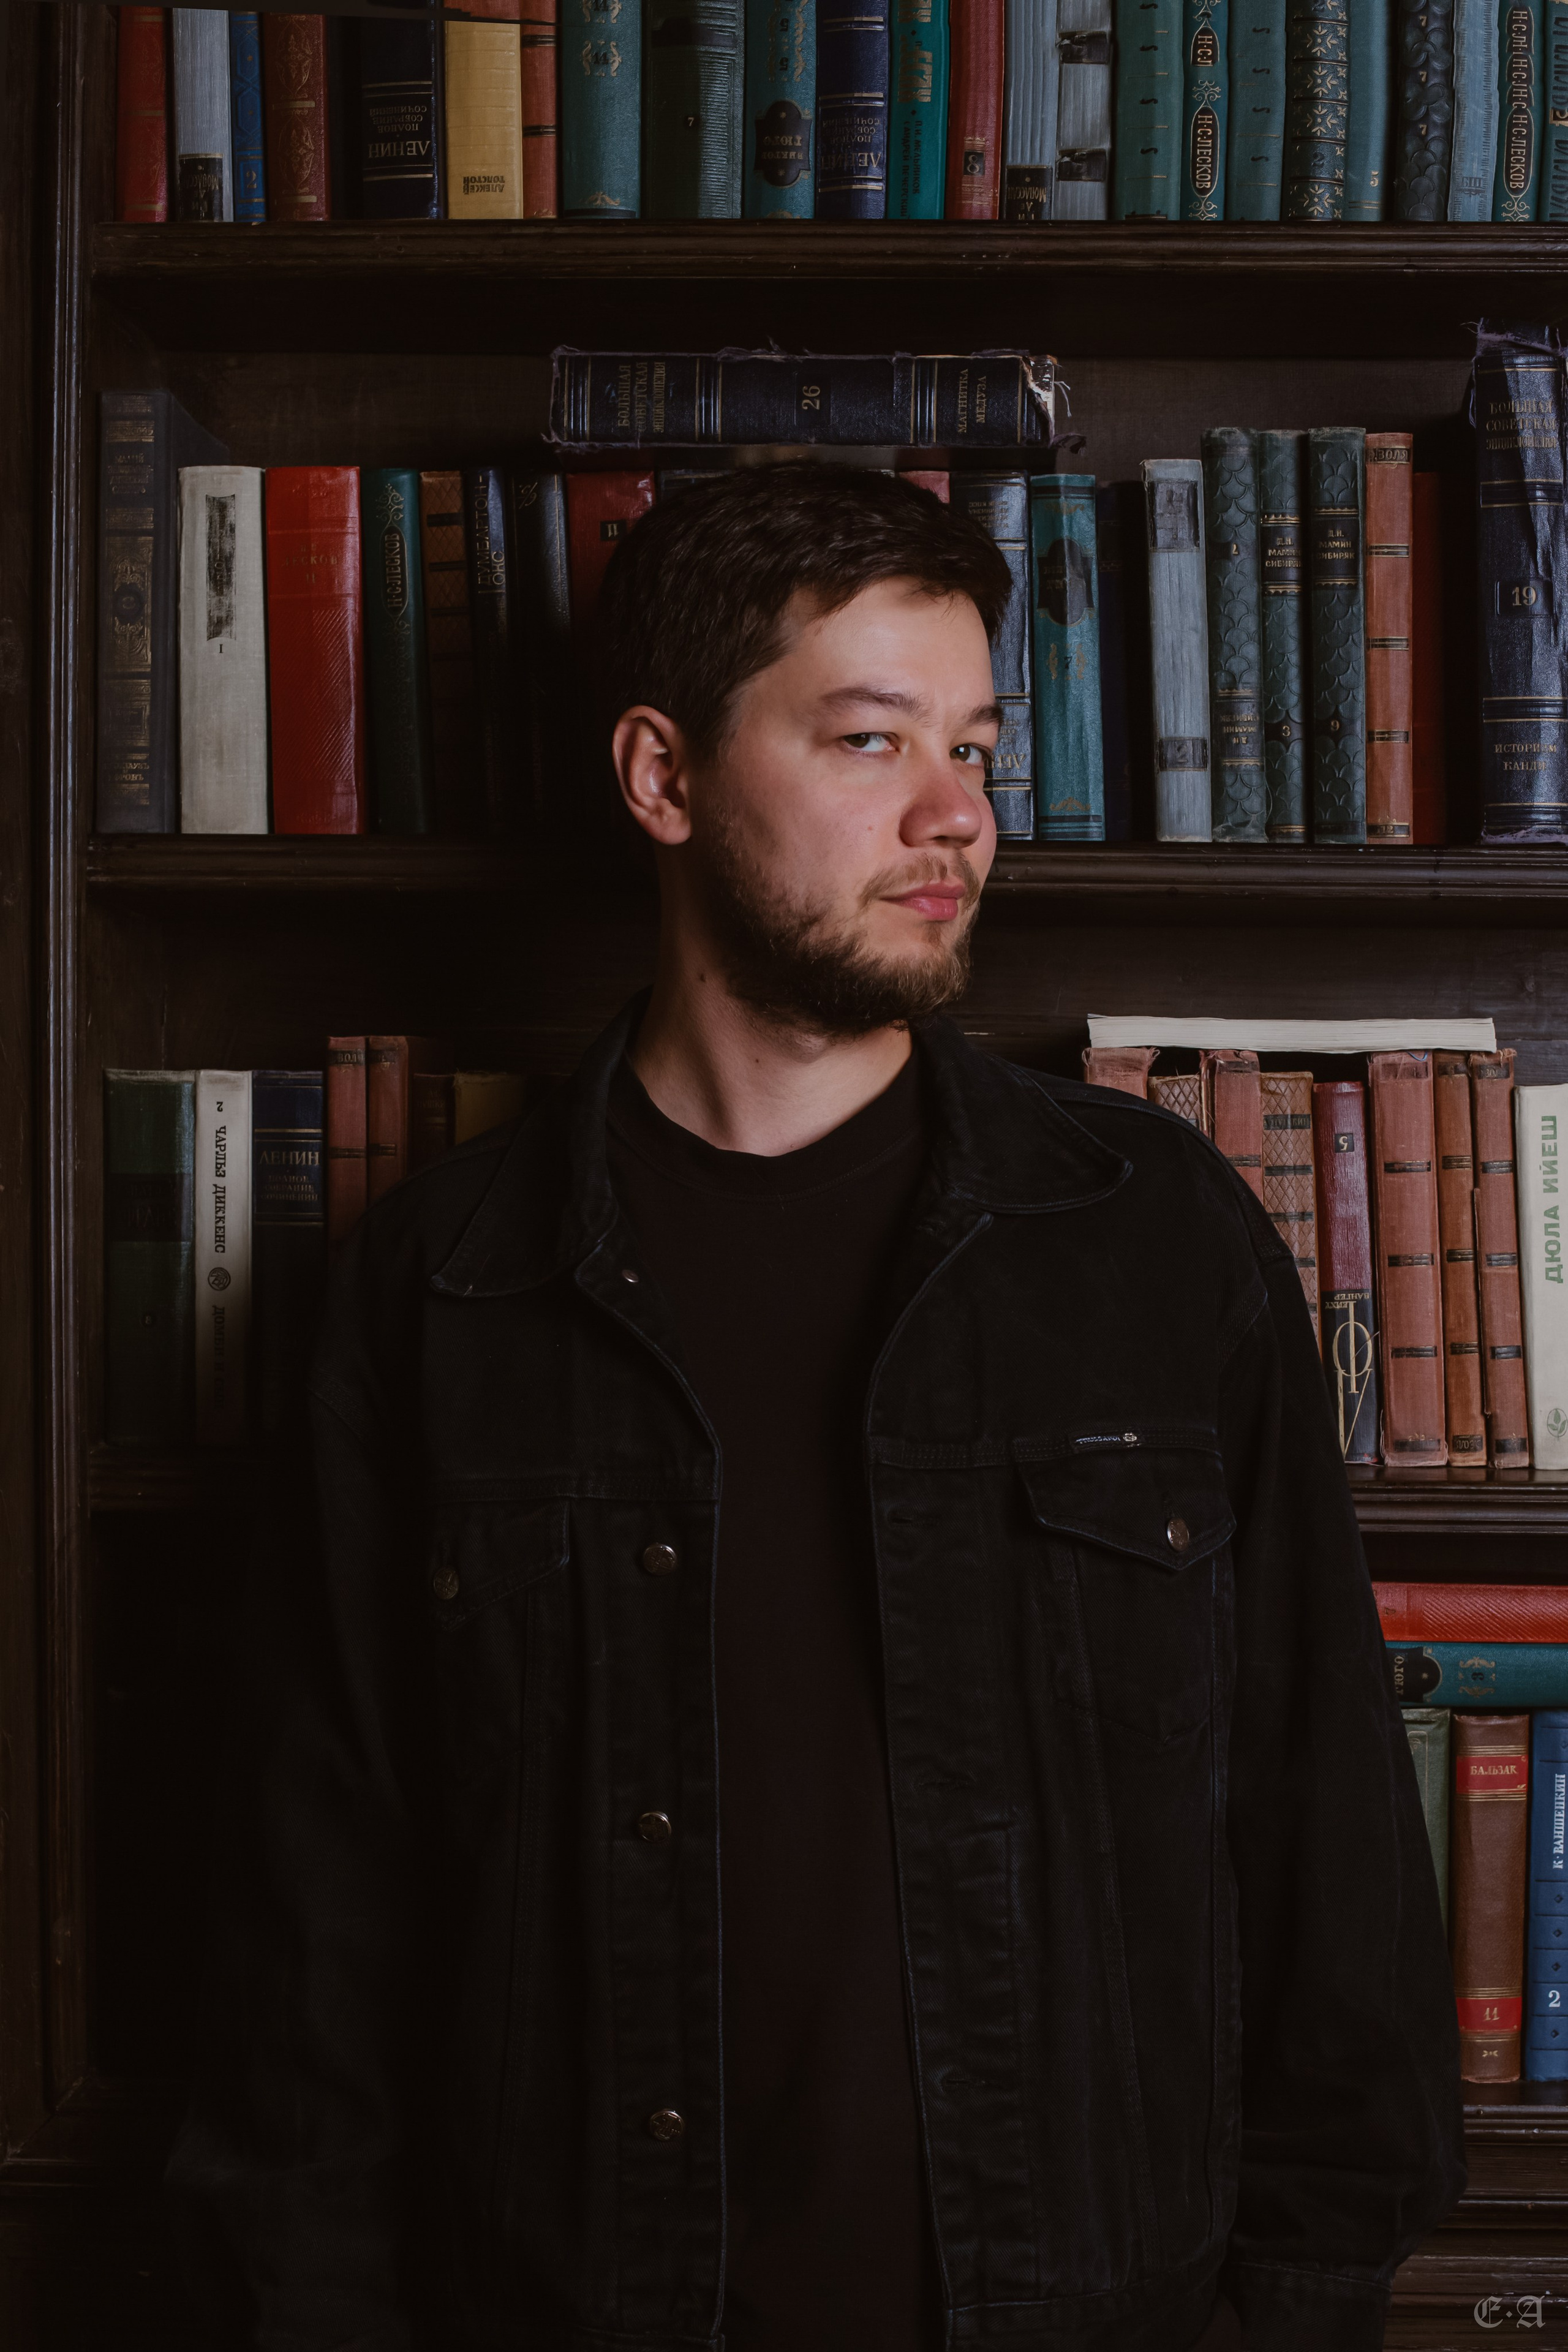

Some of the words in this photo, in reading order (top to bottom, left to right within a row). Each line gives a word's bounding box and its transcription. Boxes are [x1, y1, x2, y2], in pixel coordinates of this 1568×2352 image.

[780, 18, 788, 32] 5
[1419, 15, 1427, 26] 7
[593, 53, 609, 64] 11
[780, 58, 788, 70] 5
[1419, 71, 1427, 82] 7
[369, 105, 427, 115] СОЧИНЕНИЙ
[373, 115, 423, 125] СОБРАНИЕ
[687, 118, 695, 127] 7
[377, 124, 419, 134] ПОЛНОЕ
[1419, 124, 1427, 135] 7
[763, 136, 802, 146] ГЮГО
[368, 141, 430, 159] ЛЕНИН
[761, 151, 803, 160] ВИКТОР
[820, 152, 882, 170] ЛЕНИН
[911, 140, 922, 194] МЕЛЬНИКОВ
[967, 154, 980, 173] 8
[246, 171, 257, 189] 2
[463, 176, 505, 185] ТОЛСТОЙ
[1370, 170, 1379, 187] 5
[463, 184, 505, 195] АЛЕКСЕЙ
[618, 364, 631, 428] БОЛЬШАЯ
[635, 361, 648, 433] СОВЕТСКАЯ
[653, 361, 666, 433] ЭНЦИКЛОПЕДИЯ
[801, 385, 821, 410] 26
[957, 369, 968, 433] МАГНИТКА
[976, 375, 987, 424] МЕДУЗА
[1489, 399, 1553, 415] БОЛЬШАЯ
[1486, 417, 1556, 432] СОВЕТСКАЯ
[475, 475, 492, 586] ДУМБАРТОН-
[491, 551, 505, 585] ОКС
[1512, 586, 1537, 606] 19
[1064, 655, 1072, 669] 7
[1282, 725, 1291, 737] 3
[1330, 720, 1340, 731] 9
[1503, 761, 1547, 771] КАНДИ
[216, 1101, 224, 1112] 2
[215, 1125, 227, 1178] ЧАРЛЬЗ
[1338, 1136, 1350, 1152] 5
[259, 1150, 320, 1167] ЛЕНИН
[1540, 1115, 1559, 1194] ИЙЕШ
[269, 1174, 310, 1183] ПОЛНОЕ
[264, 1183, 315, 1193] СОБРАНИЕ
[212, 1185, 227, 1254] ДИККЕНС
[1544, 1205, 1564, 1284] ДЮЛА
[1334, 1292, 1370, 1301] ВАНГЕР
[144, 1314, 152, 1325] 8
[1469, 1765, 1518, 1776] БАЛЬЗАК
[1548, 1989, 1561, 2008] 2
[1482, 2007, 1500, 2022] 11
